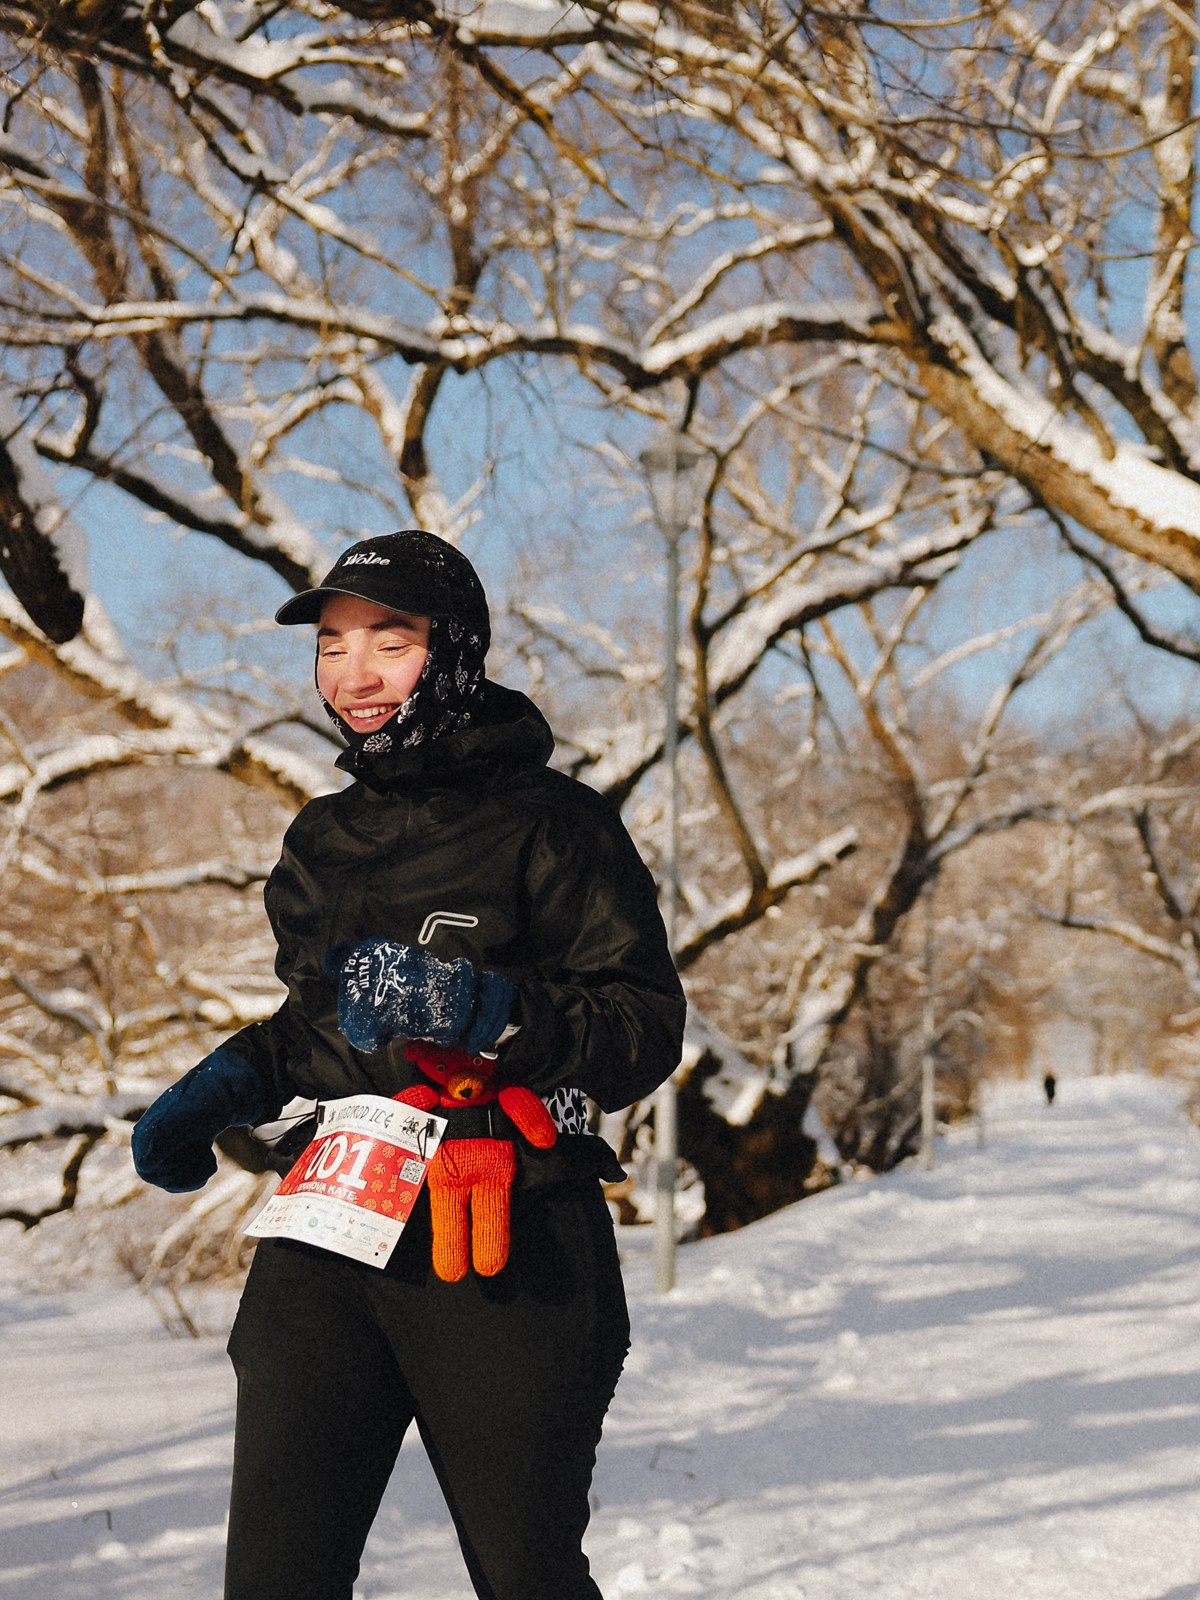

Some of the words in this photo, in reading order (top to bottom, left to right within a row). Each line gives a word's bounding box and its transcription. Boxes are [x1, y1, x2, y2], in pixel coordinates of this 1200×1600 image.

[344, 952, 361, 973] FOX
[358, 956, 370, 989] ULTRA
[369, 1108, 394, 1128] ICE
[304, 1134, 374, 1190] 001
[328, 1184, 357, 1201] KATE
